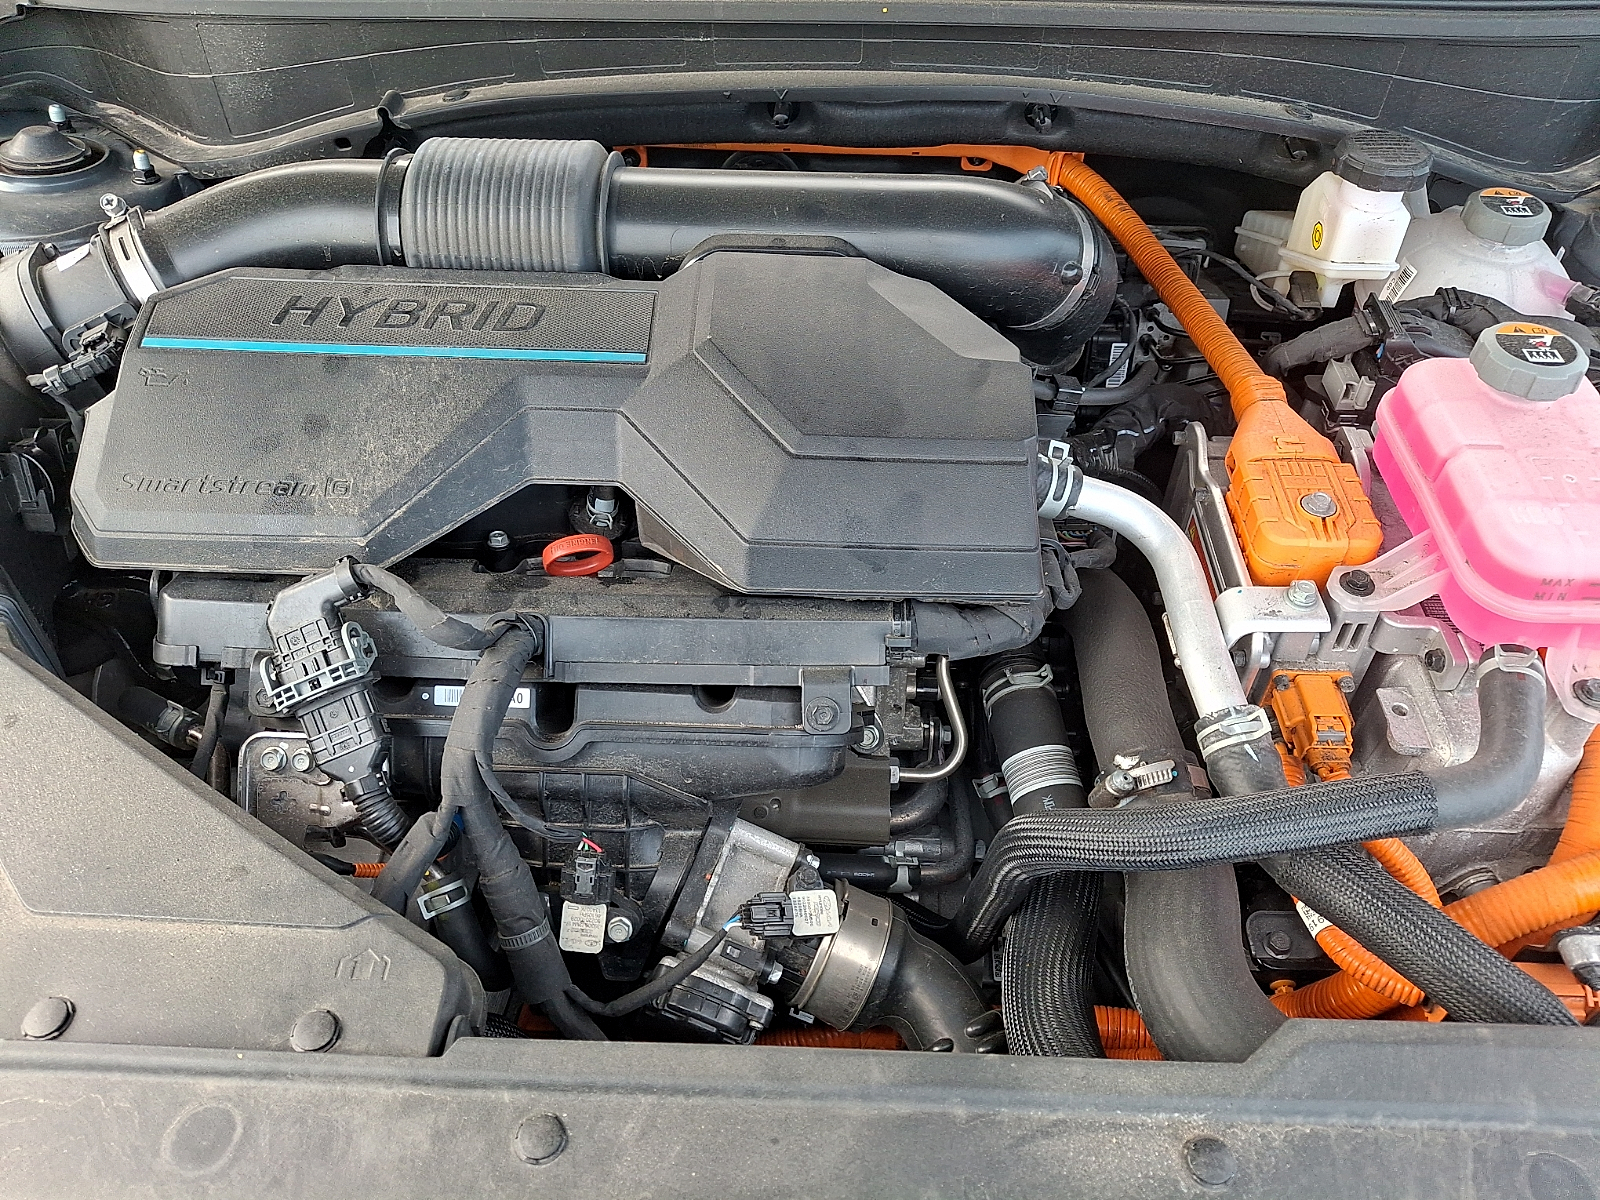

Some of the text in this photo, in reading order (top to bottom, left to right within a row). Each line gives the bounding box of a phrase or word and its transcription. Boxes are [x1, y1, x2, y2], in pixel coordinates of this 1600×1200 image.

[270, 295, 547, 332] HYBRID
[117, 472, 316, 498] Smartstream
[1540, 578, 1575, 587] MAX
[1533, 592, 1568, 601] MIN
